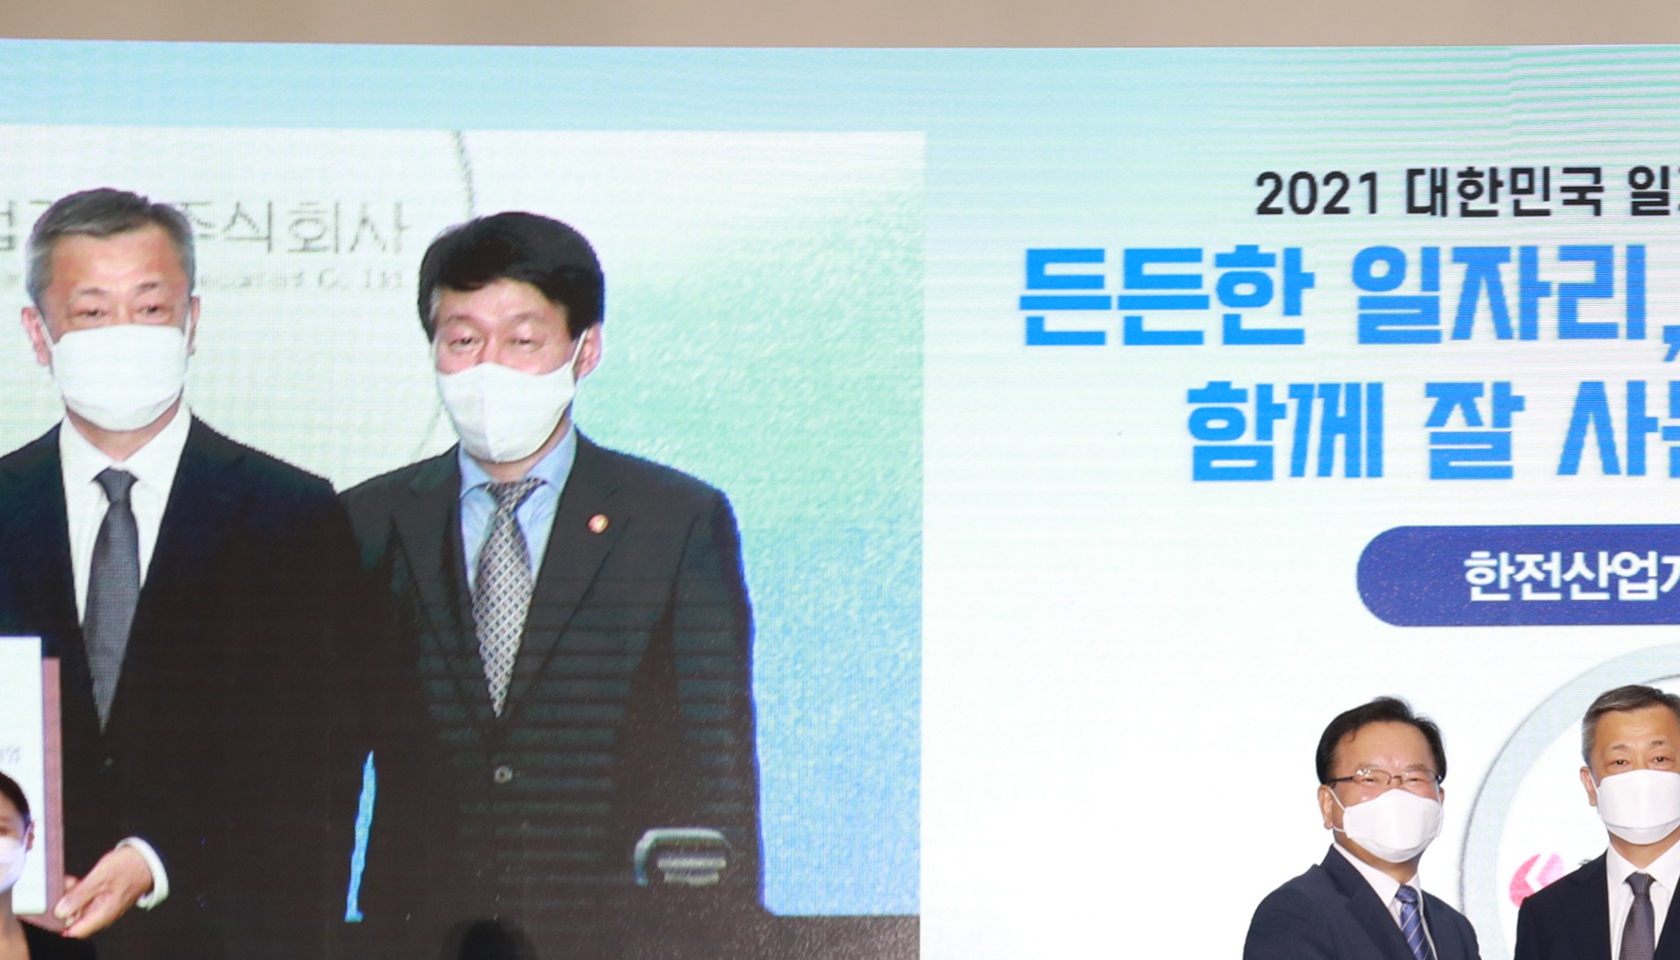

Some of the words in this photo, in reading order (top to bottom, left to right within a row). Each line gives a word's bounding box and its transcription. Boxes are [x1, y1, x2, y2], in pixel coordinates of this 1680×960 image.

[1256, 171, 1378, 216] 2021
[1406, 167, 1606, 218] 대한민국
[1018, 245, 1317, 347] 든든한
[1186, 381, 1386, 483] 함께
[1425, 381, 1526, 481] 잘
